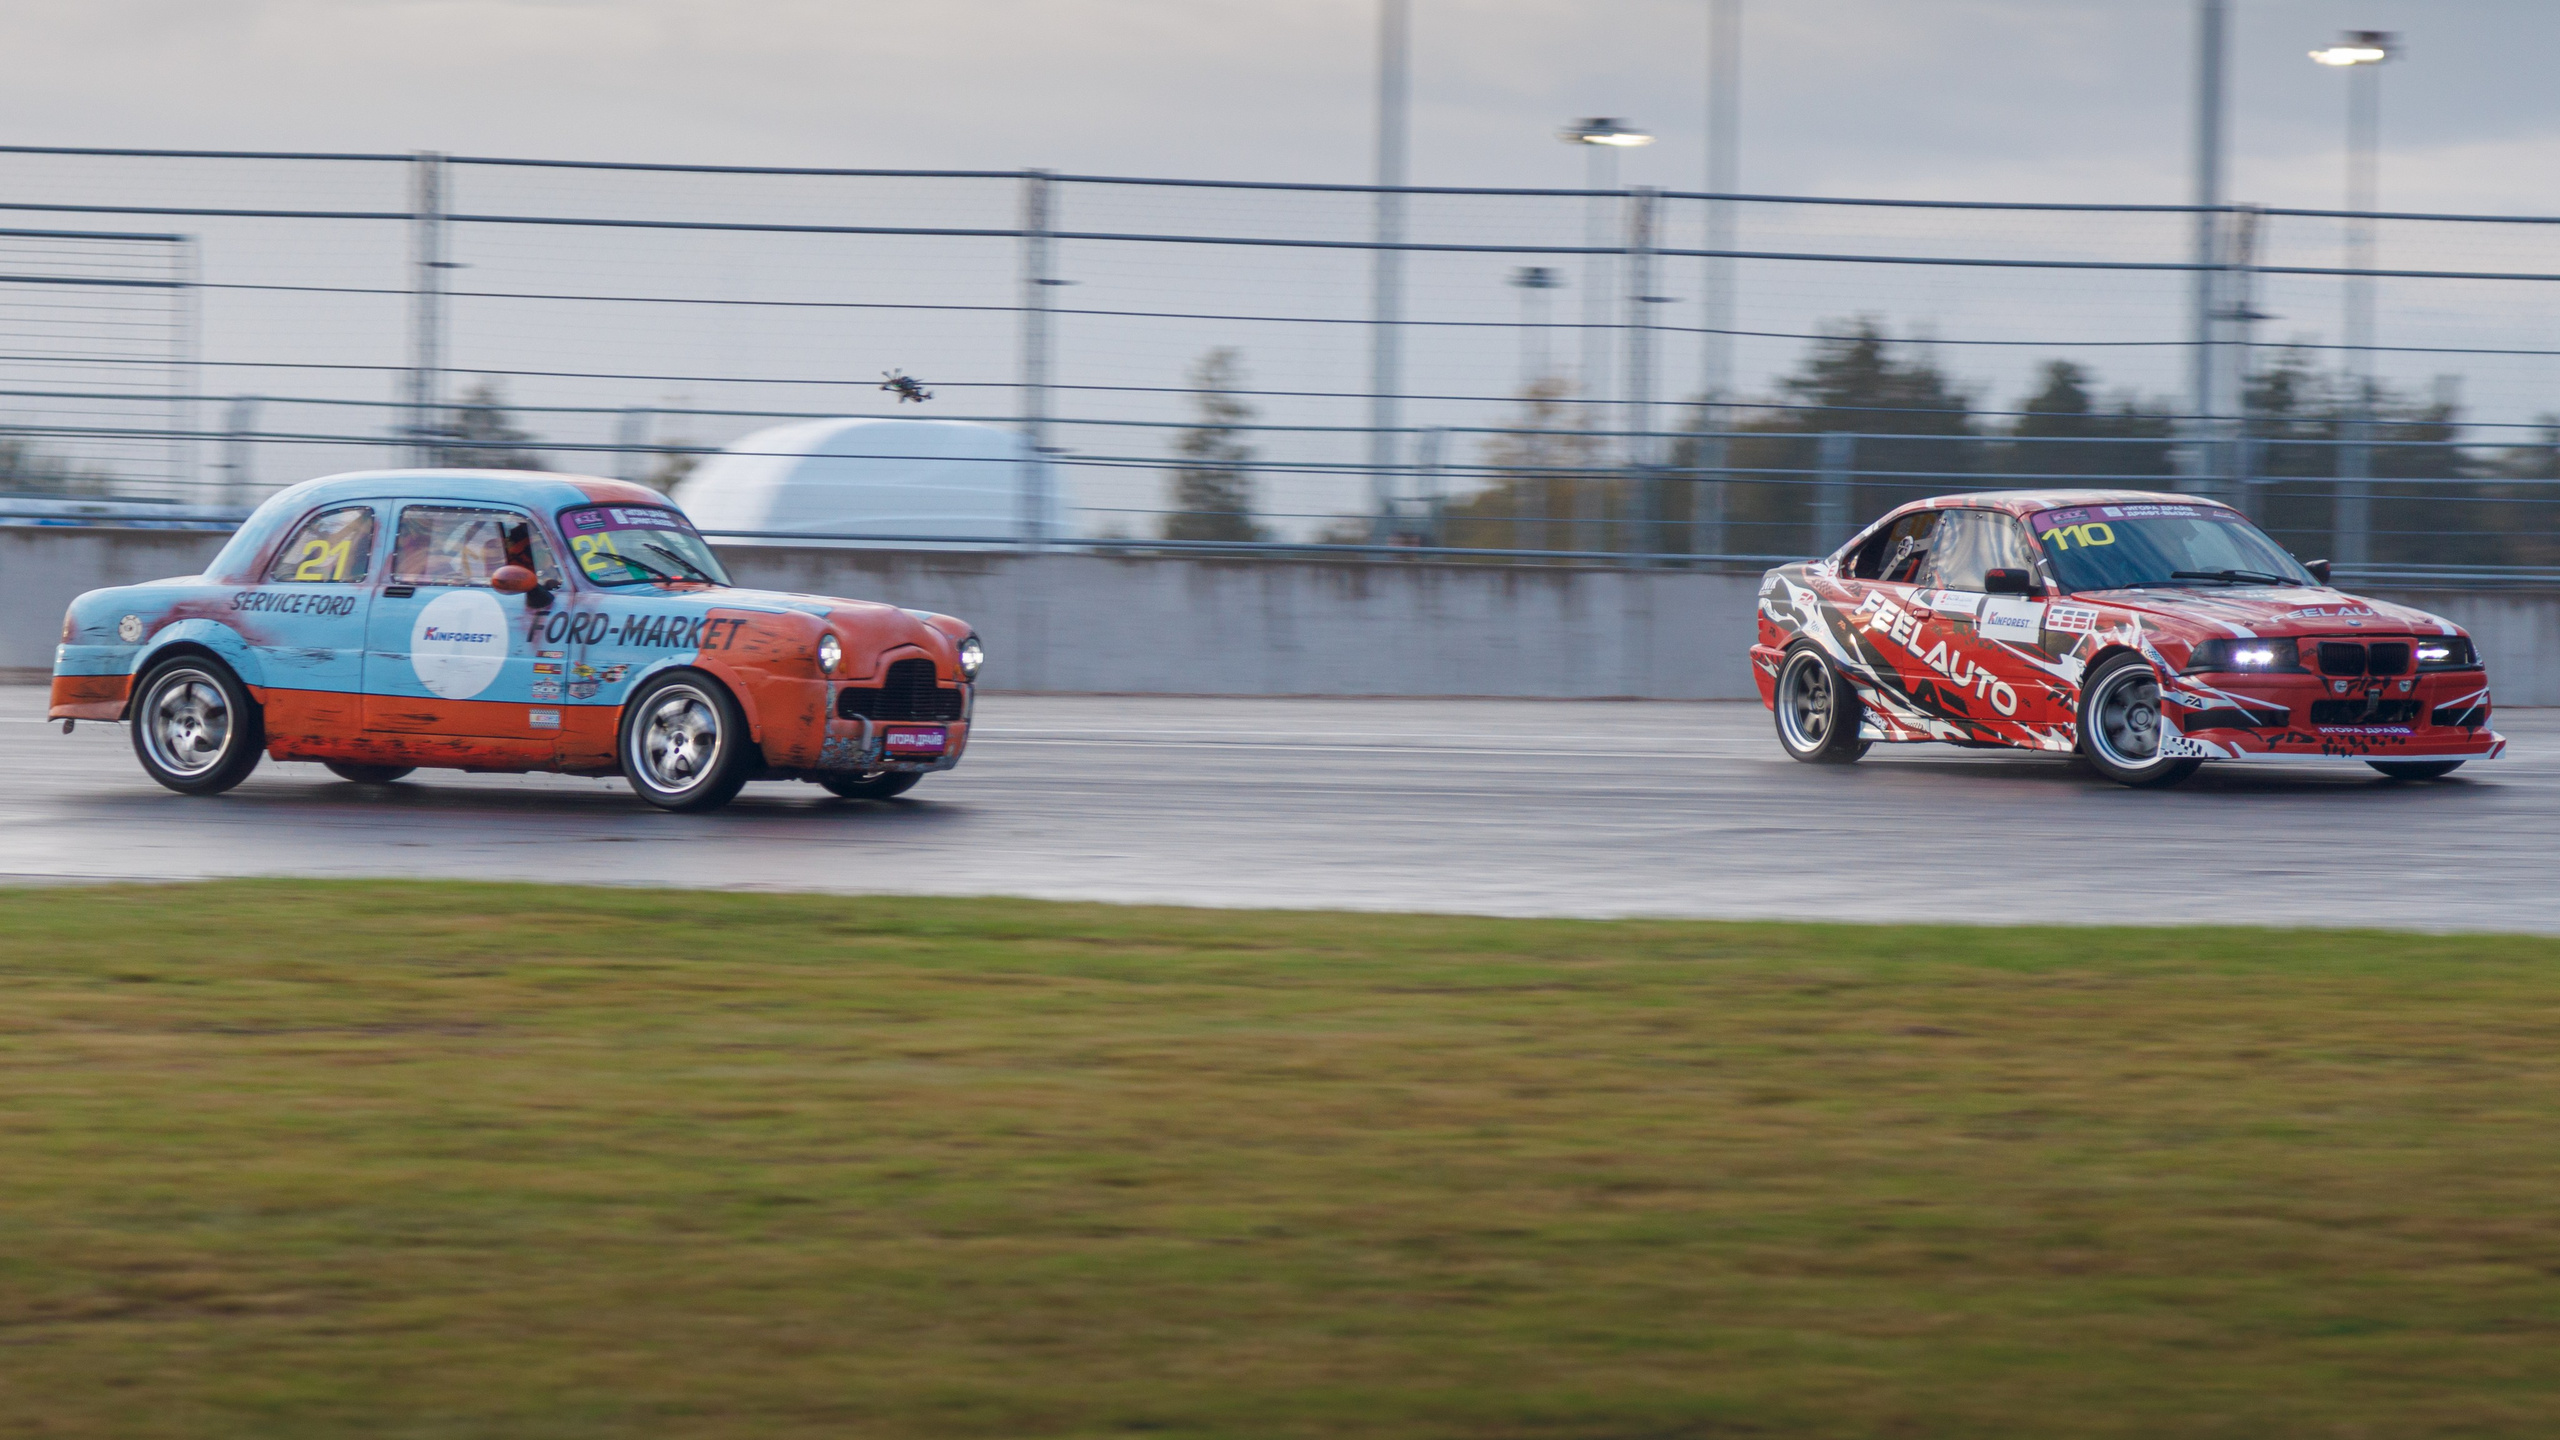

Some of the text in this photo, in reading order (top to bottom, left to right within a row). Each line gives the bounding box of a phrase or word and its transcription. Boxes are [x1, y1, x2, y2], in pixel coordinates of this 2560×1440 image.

[572, 532, 625, 572] 21
[2041, 522, 2115, 550] 110
[295, 539, 352, 581] 21
[229, 591, 356, 616] SERVICE FORD
[526, 610, 747, 650] FORD-MARKET
[1852, 589, 2018, 717] FEELAUTO
[886, 731, 944, 747] ИГОРА ДРАЙВ
[2318, 725, 2411, 735] ИГОРА ДРАЙВ
